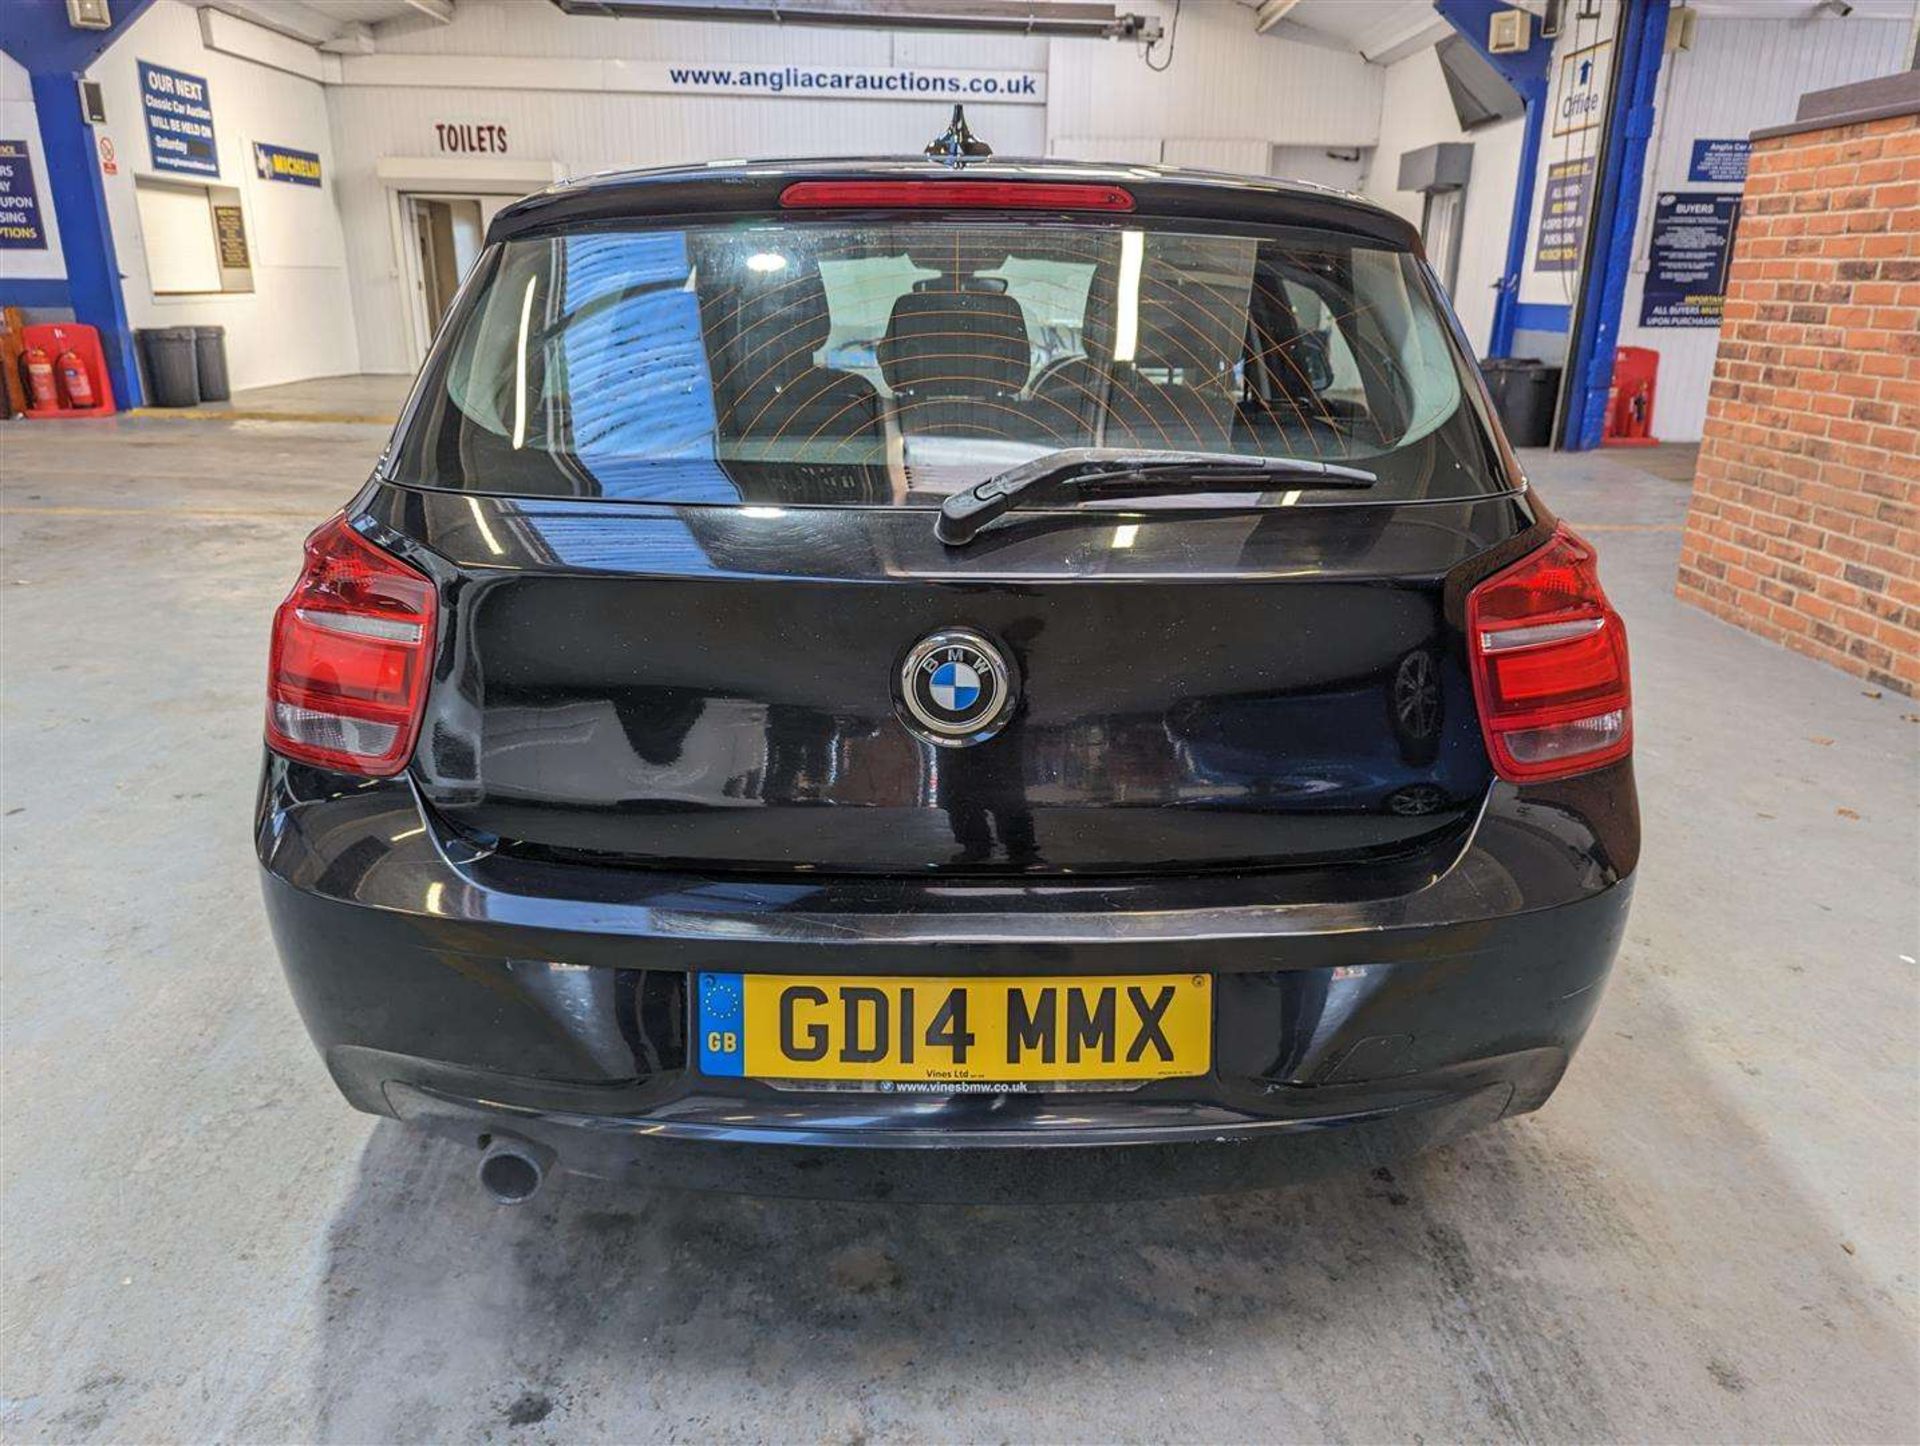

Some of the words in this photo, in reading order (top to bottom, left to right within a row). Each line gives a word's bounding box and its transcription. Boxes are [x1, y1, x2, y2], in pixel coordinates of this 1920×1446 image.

[148, 70, 175, 94] OUR
[176, 78, 203, 101] NEXT
[670, 66, 1037, 96] www.angliacarauctions.co.uk
[145, 94, 173, 112] Classic
[173, 101, 186, 115] Car
[1562, 93, 1599, 119] Office
[150, 114, 171, 131] WILL
[170, 118, 181, 132] BE
[181, 121, 201, 136] HELD
[201, 125, 213, 138] ON
[155, 135, 187, 155] Saturday
[435, 124, 507, 153] TOILETS
[1734, 143, 1747, 151] Car
[272, 153, 321, 178] MICHELIN
[1, 196, 34, 208] UPON
[1675, 203, 1715, 214] BUYERS
[1652, 305, 1668, 315] ALL
[1646, 316, 1671, 326] UPON
[922, 648, 990, 676] BMW
[779, 986, 975, 1064] GD14
[1006, 986, 1177, 1065] MMX
[707, 1032, 738, 1054] GB
[926, 1069, 952, 1079] Vines
[954, 1069, 969, 1079] Ltd
[897, 1081, 1028, 1094] www.vinesbmw.co.uk
